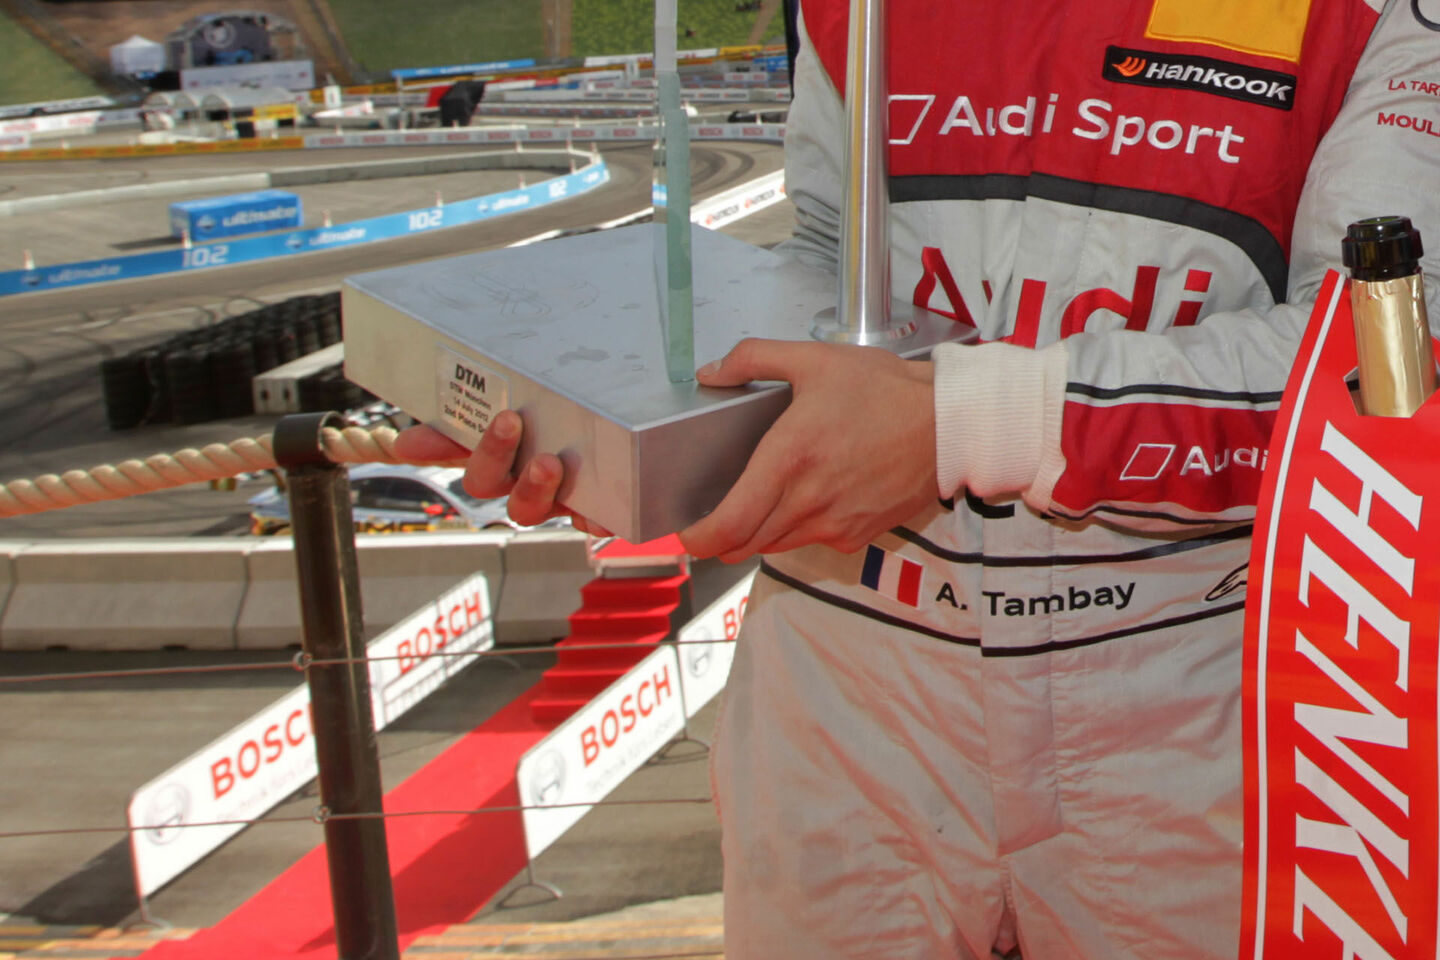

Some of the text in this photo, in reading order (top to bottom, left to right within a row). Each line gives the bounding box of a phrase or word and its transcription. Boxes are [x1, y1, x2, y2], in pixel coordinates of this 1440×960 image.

[1388, 79, 1407, 91] LA
[1072, 98, 1245, 164] Sport
[408, 209, 443, 230] 102
[183, 244, 229, 269] 102
[455, 363, 486, 394] DTM
[1179, 445, 1270, 477] Audi
[935, 581, 1136, 617] A. Tambay
[397, 591, 483, 676] BOSCH
[580, 663, 672, 768] BOSCH
[210, 701, 316, 801] BOSC
